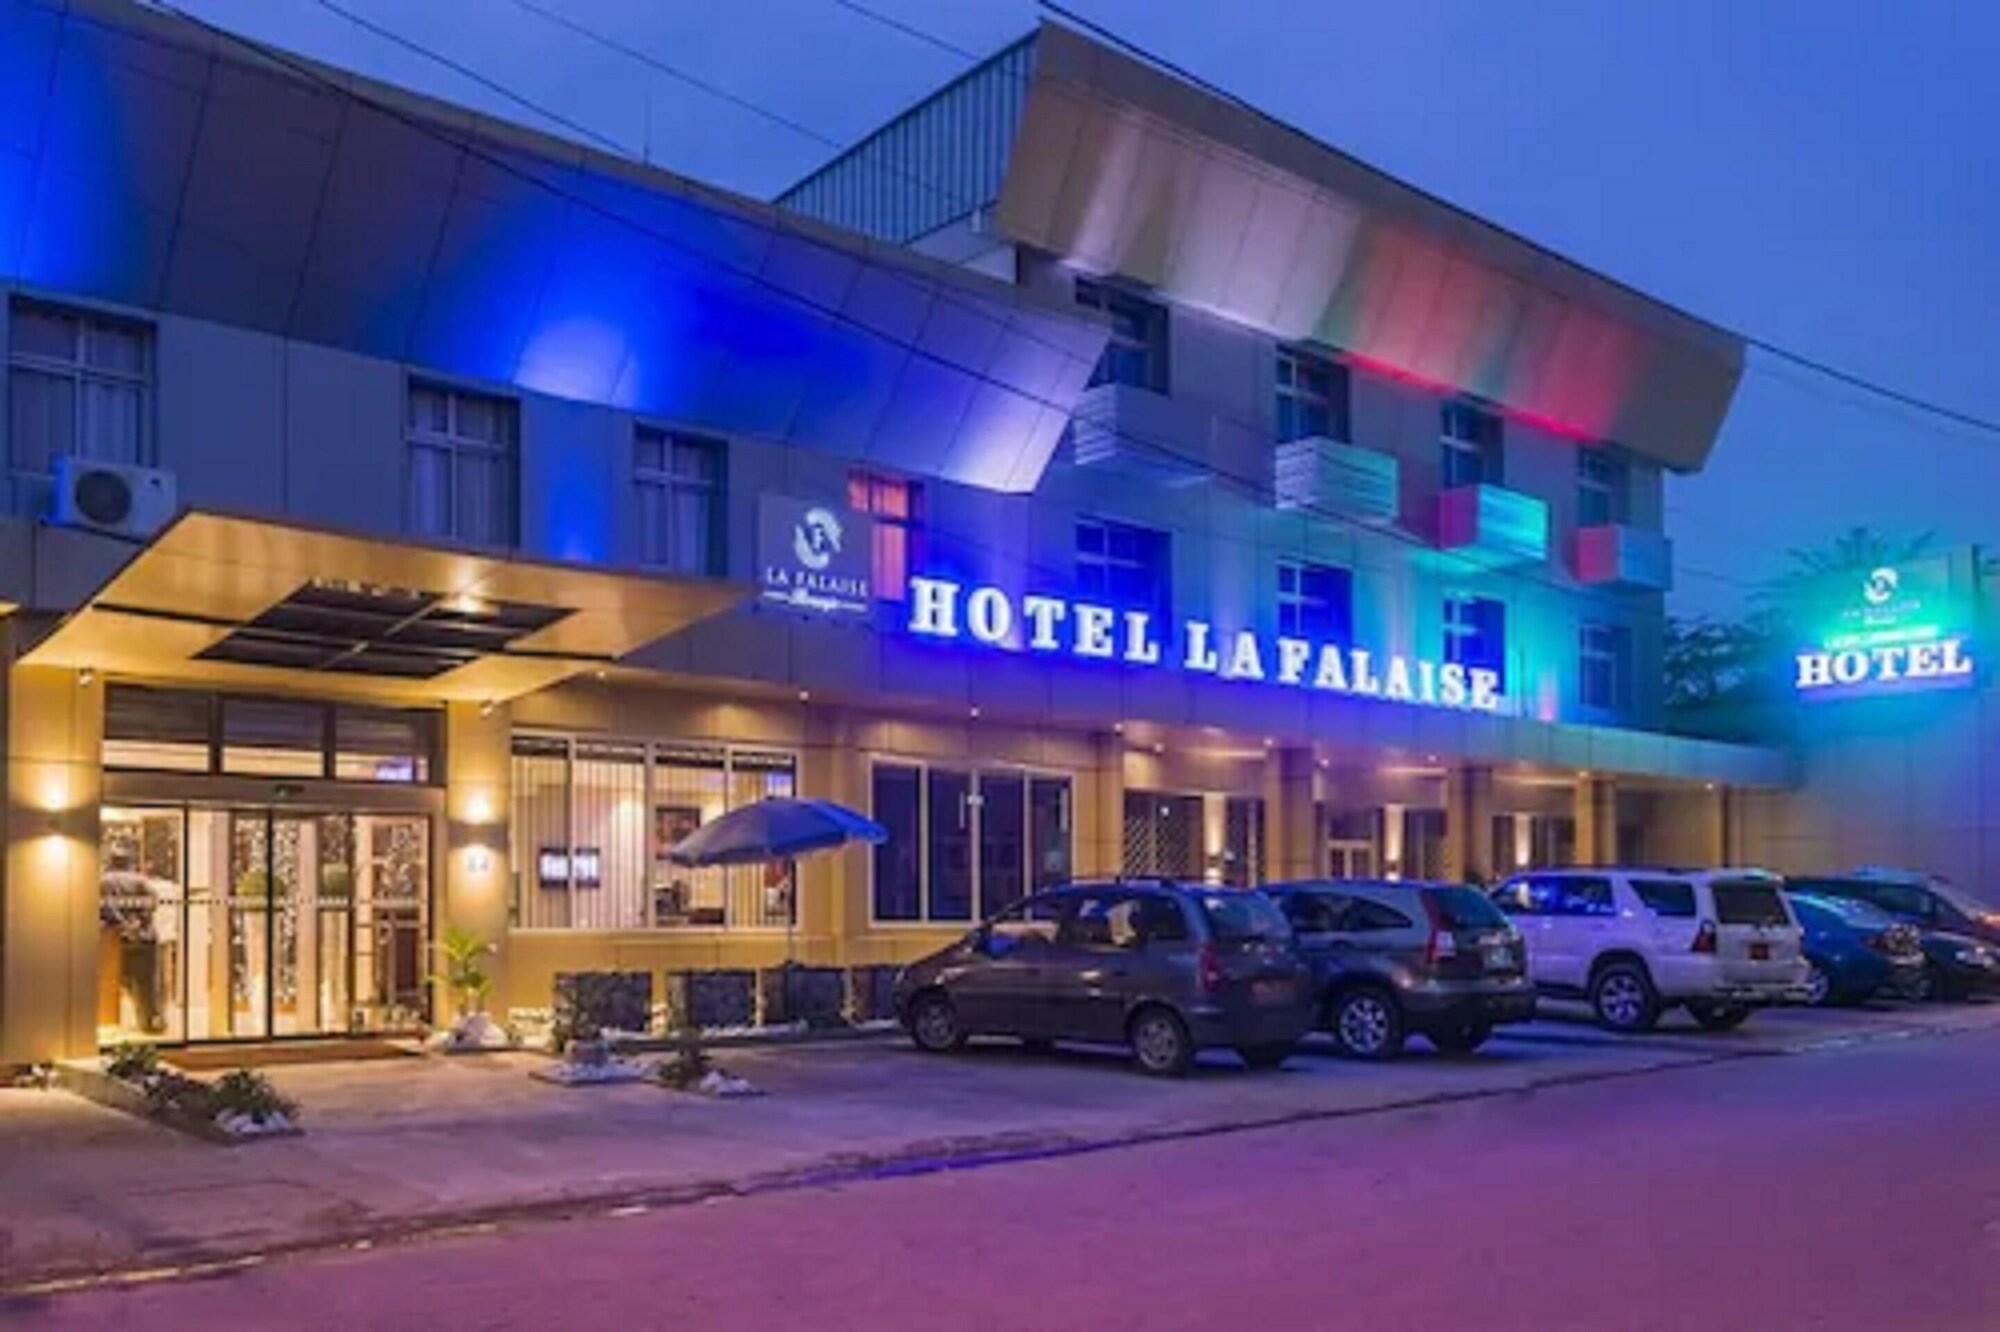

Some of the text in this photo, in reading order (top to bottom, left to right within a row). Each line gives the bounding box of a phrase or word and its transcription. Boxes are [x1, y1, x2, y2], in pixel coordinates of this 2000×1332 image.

[766, 566, 789, 585] LA
[908, 576, 1500, 711] HOTEL LA FALAISE
[1796, 640, 1973, 688] HOTEL
